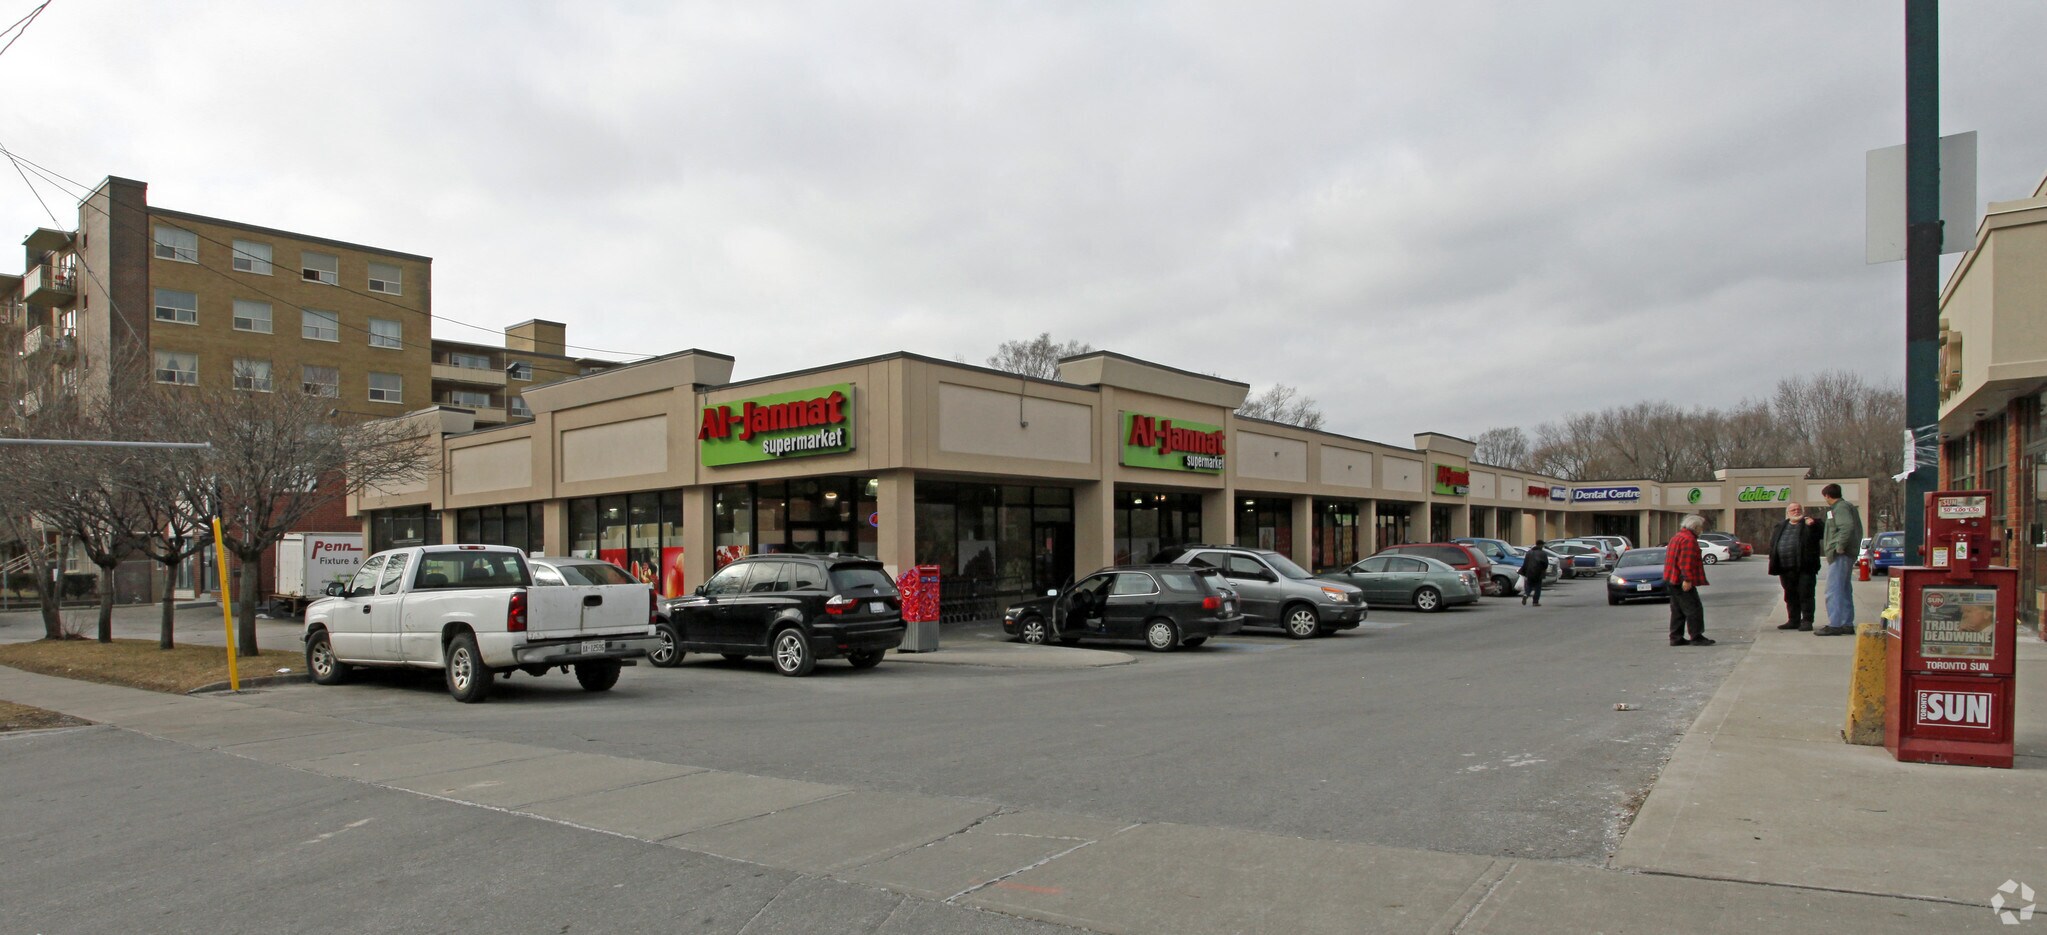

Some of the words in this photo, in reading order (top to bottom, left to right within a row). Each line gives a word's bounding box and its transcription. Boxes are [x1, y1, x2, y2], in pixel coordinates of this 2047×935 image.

[698, 391, 846, 440] Al-Jannat
[763, 428, 842, 456] supermarket
[1128, 415, 1226, 455] Al-Jannat
[1187, 455, 1225, 469] supermarket
[1576, 490, 1607, 499] Dental
[1608, 489, 1640, 499] Centre
[1739, 487, 1776, 502] dollar
[311, 540, 362, 559] Penn
[320, 557, 349, 565] Fixture
[1925, 620, 1960, 631] TRADE
[1924, 630, 1991, 642] DEADWHINE
[1926, 660, 1967, 670] TORONTO
[1970, 662, 1989, 671] SUN
[1920, 692, 1928, 721] TORONTO
[1927, 692, 1987, 724] SUN
